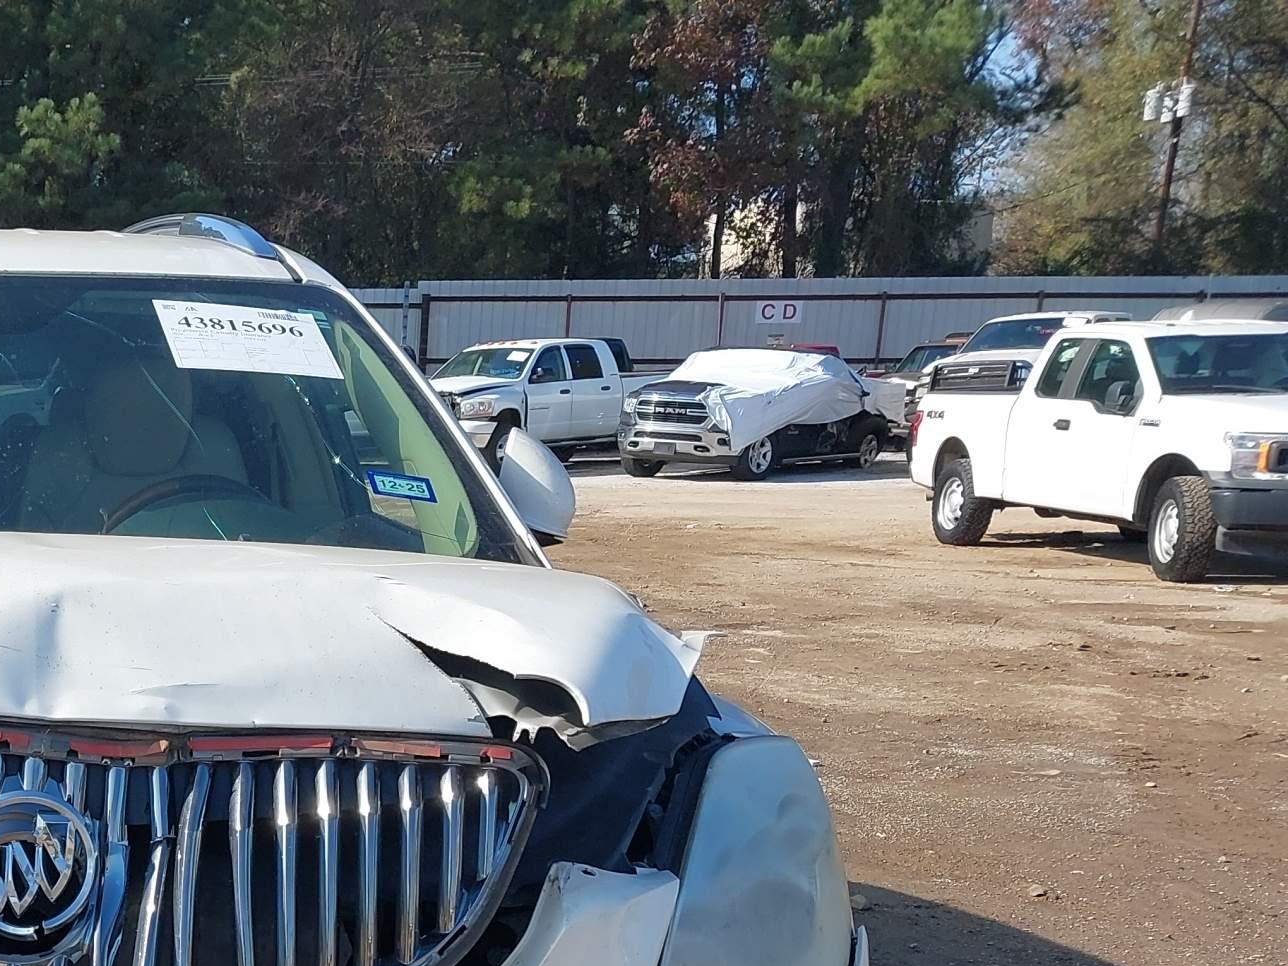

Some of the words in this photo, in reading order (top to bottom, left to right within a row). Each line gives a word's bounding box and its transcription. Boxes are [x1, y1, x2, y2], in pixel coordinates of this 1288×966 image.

[761, 303, 776, 320] C
[783, 303, 797, 320] D
[177, 315, 304, 338] 43815696
